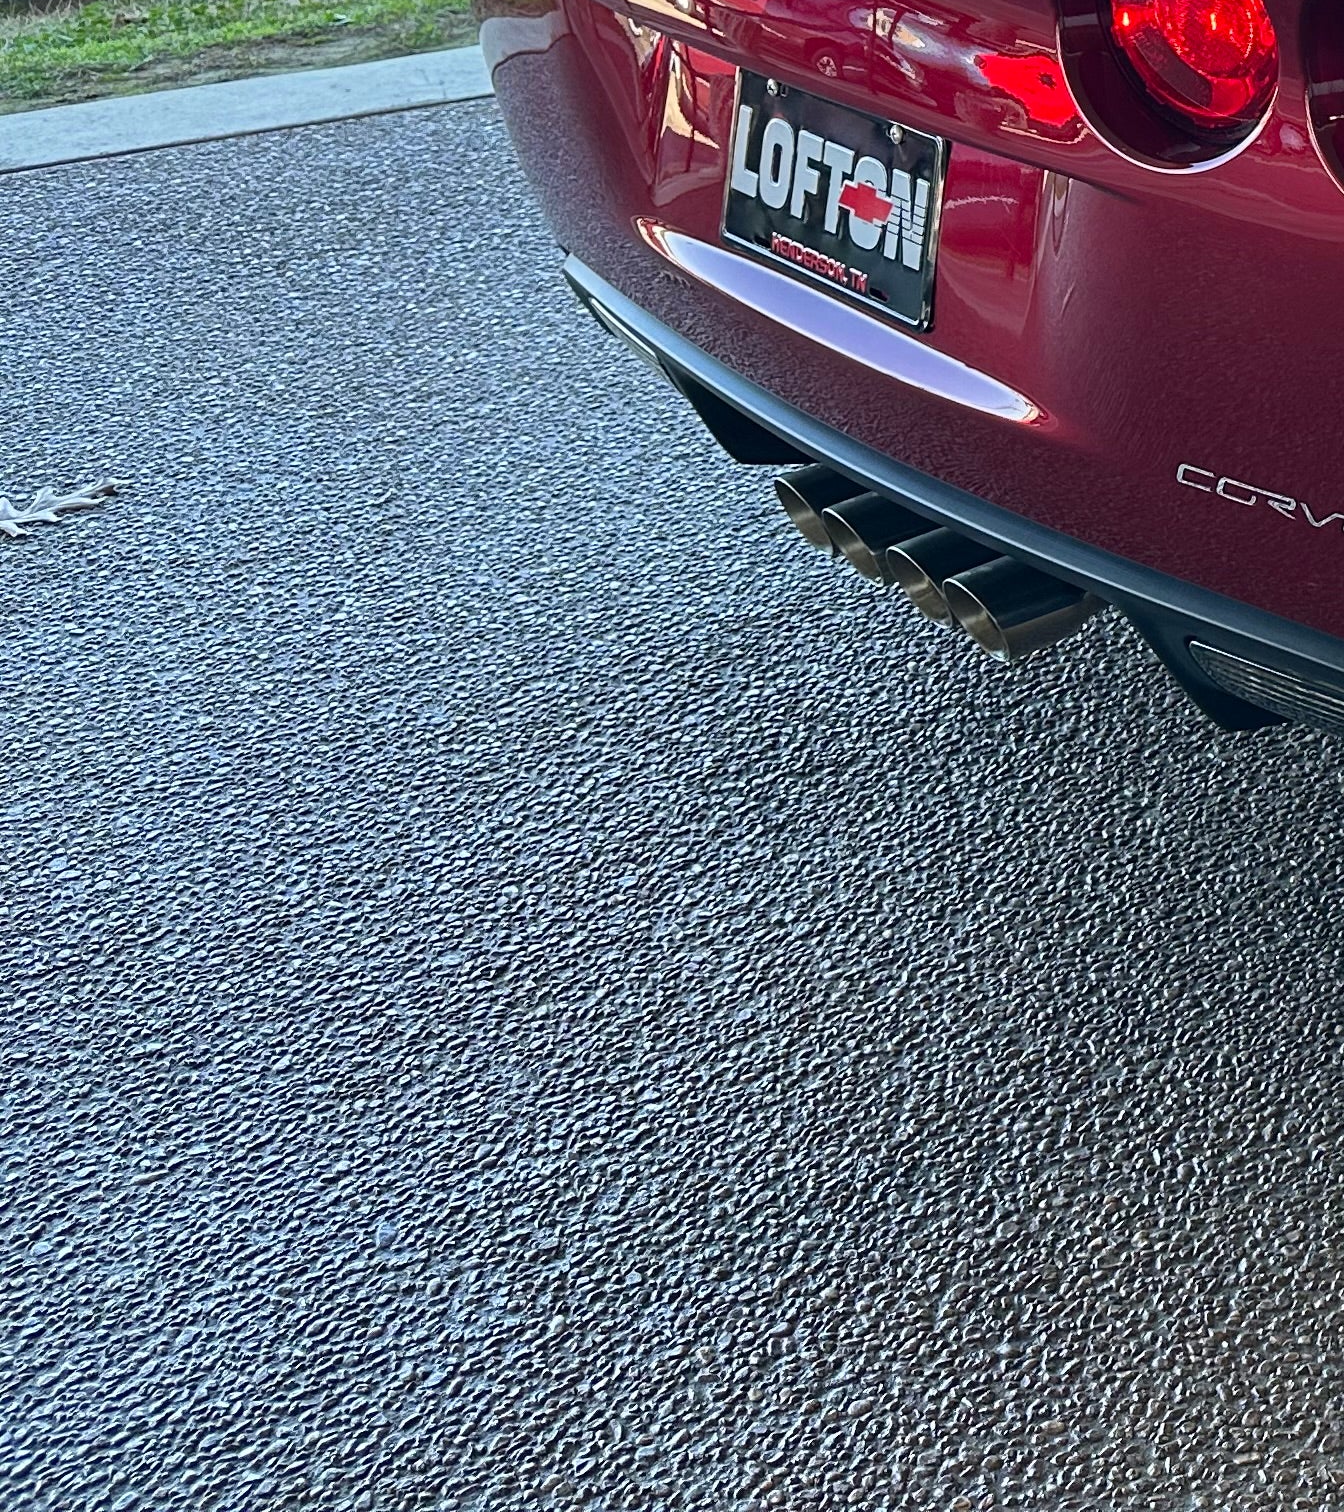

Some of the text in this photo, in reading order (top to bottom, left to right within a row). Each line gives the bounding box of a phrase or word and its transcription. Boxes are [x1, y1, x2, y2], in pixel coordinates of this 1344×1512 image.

[731, 103, 931, 271] LOFTON
[771, 231, 868, 293] HENDERSON, TN
